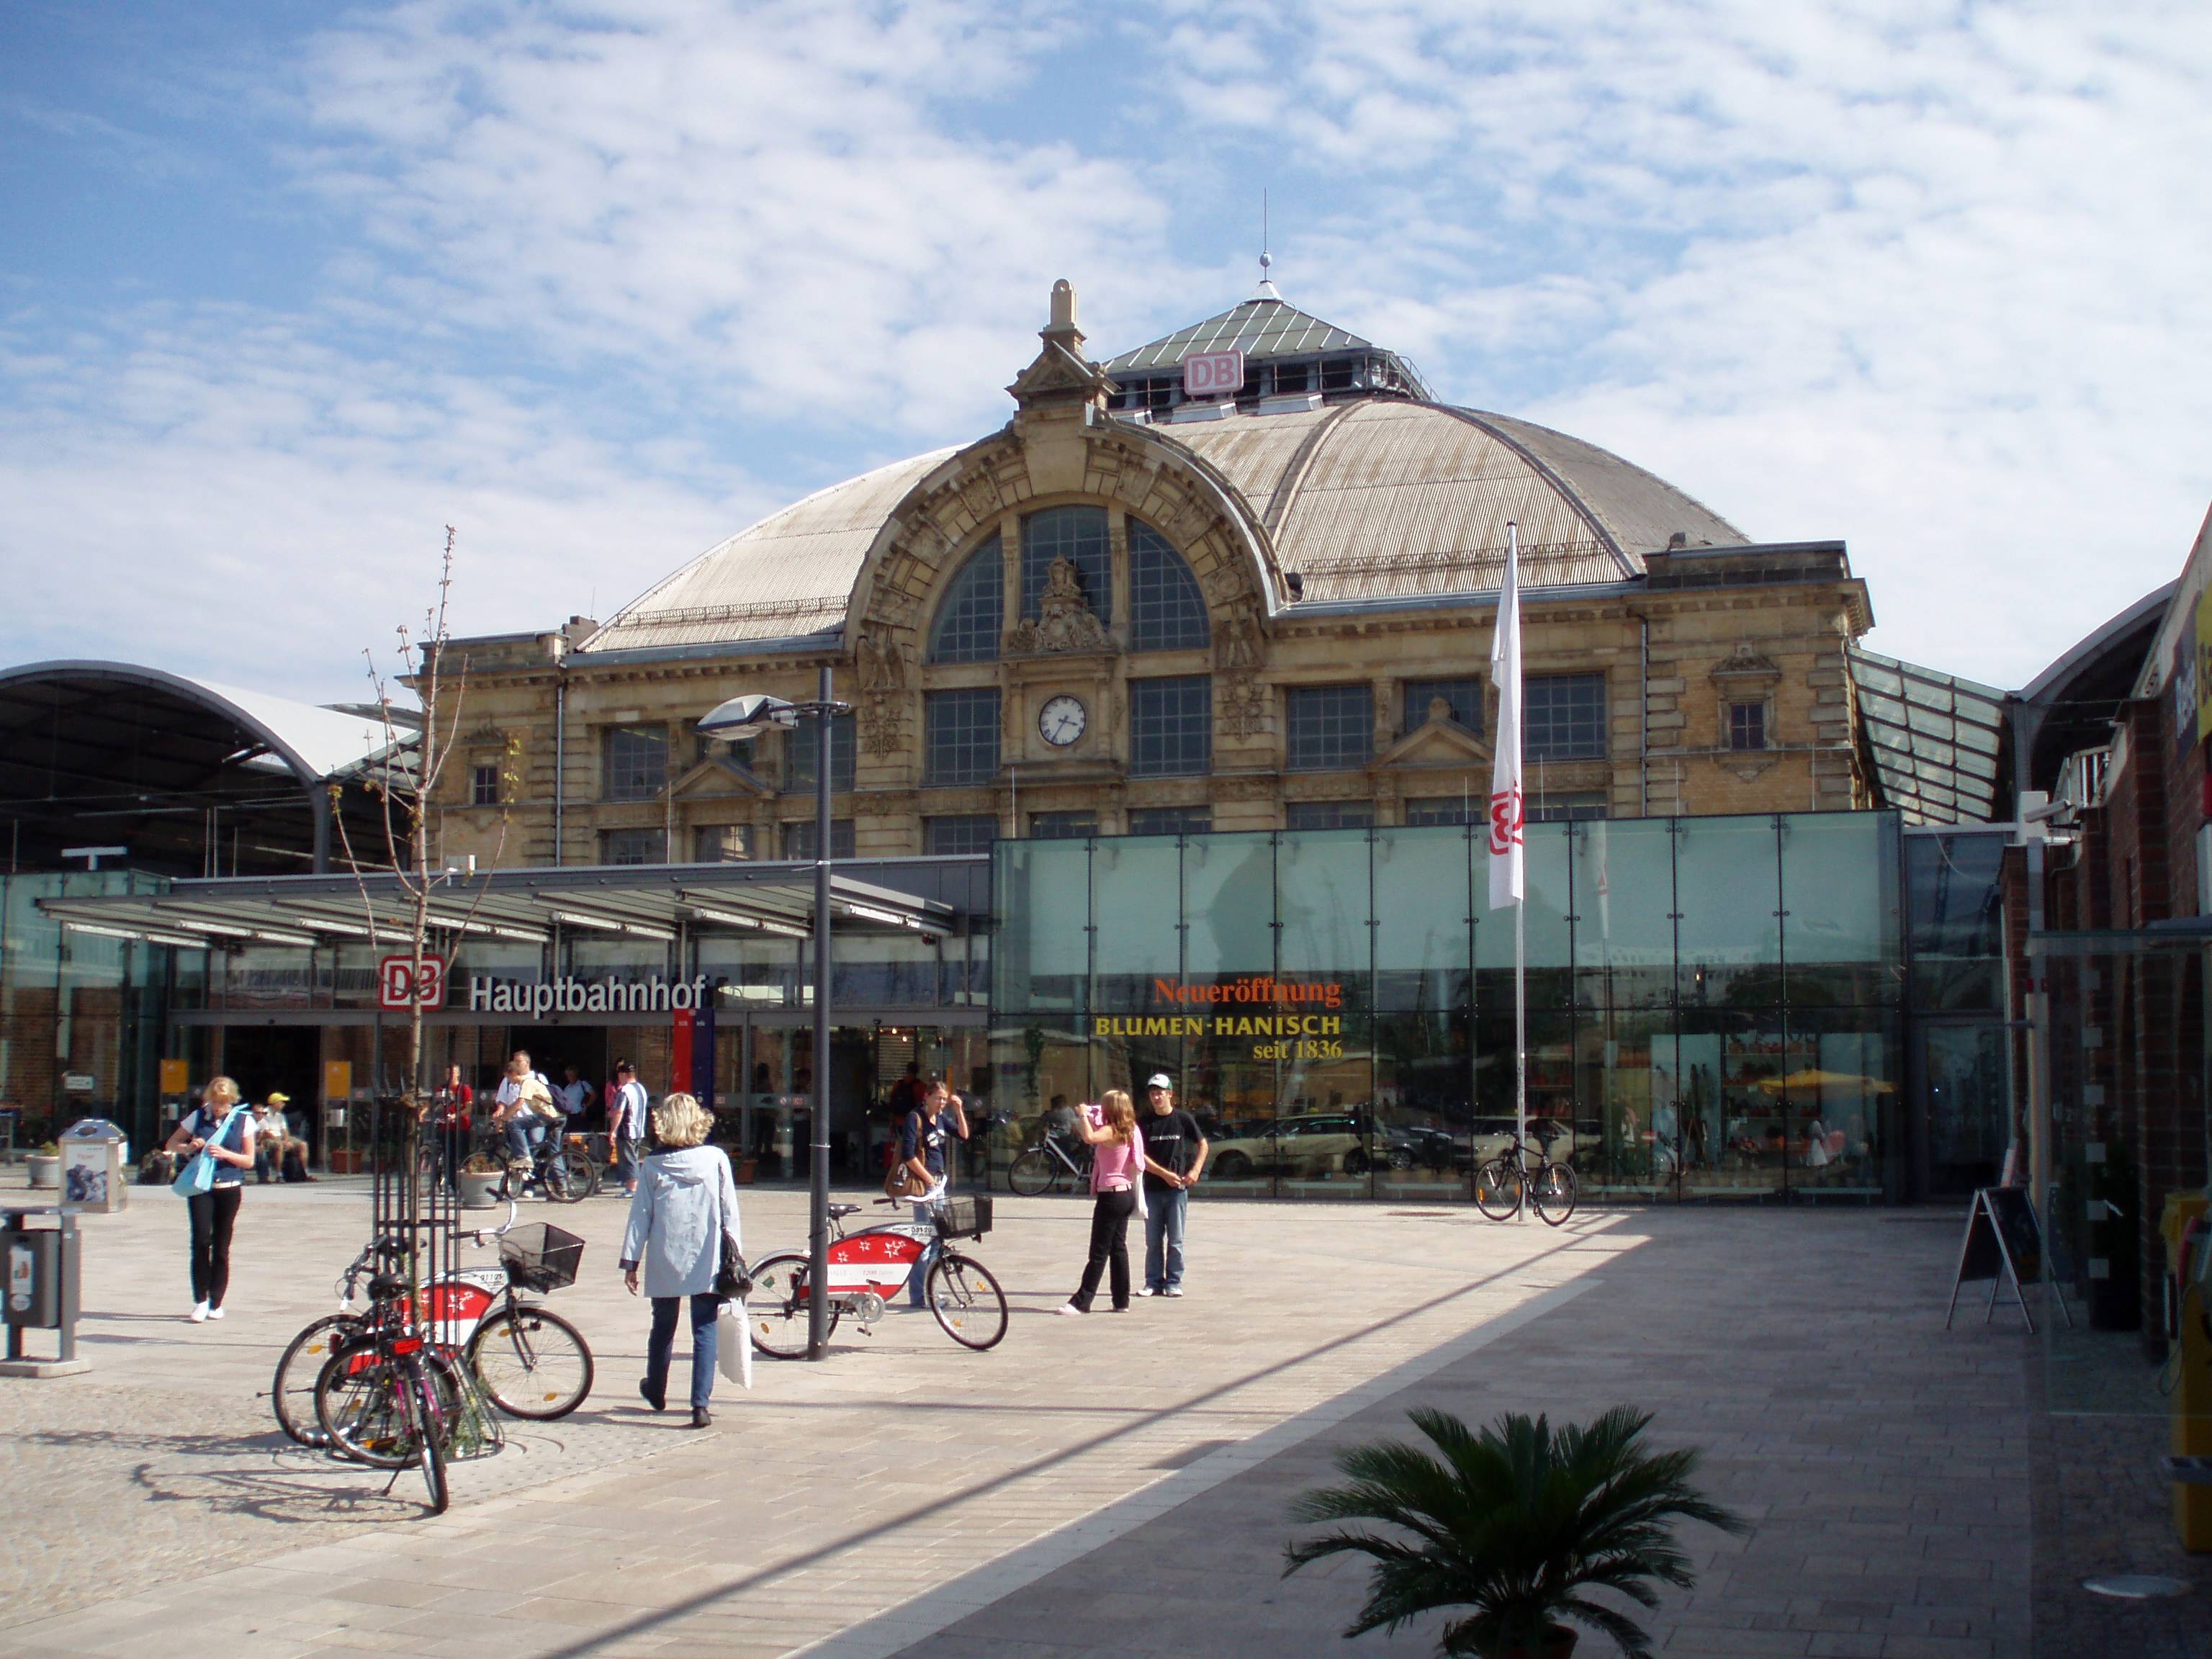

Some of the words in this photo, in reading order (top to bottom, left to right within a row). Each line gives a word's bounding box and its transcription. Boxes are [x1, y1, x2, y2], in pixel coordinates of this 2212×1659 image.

[1192, 358, 1234, 388] DB
[389, 964, 436, 1002] DB
[469, 974, 706, 1020] Hauptbahnhof
[1154, 978, 1341, 1007] Neueröffnung
[1095, 1015, 1340, 1037] BLUMEN-HANISCH
[1254, 1042, 1289, 1060] seit
[1296, 1040, 1343, 1059] 1836
